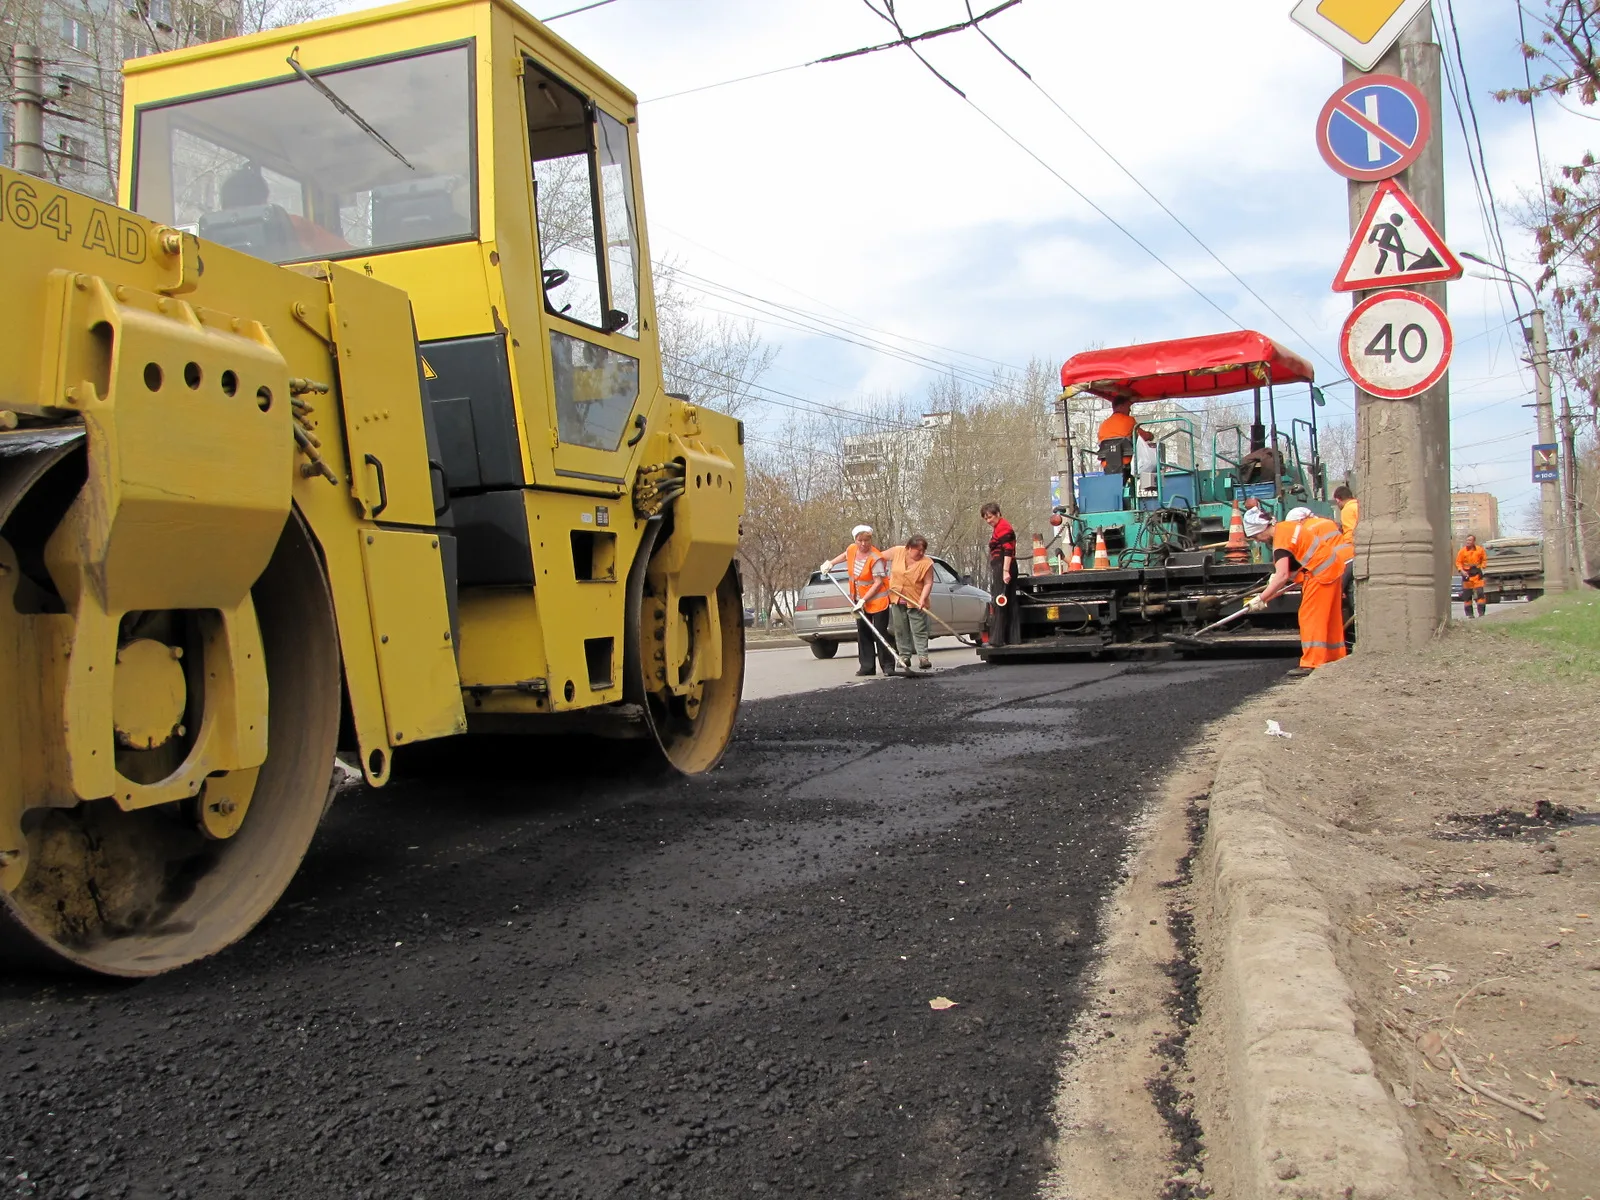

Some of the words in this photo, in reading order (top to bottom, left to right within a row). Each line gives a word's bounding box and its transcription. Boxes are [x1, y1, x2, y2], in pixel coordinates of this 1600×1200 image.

[0, 174, 72, 242] 64
[82, 208, 147, 265] AD
[1364, 323, 1428, 364] 40
